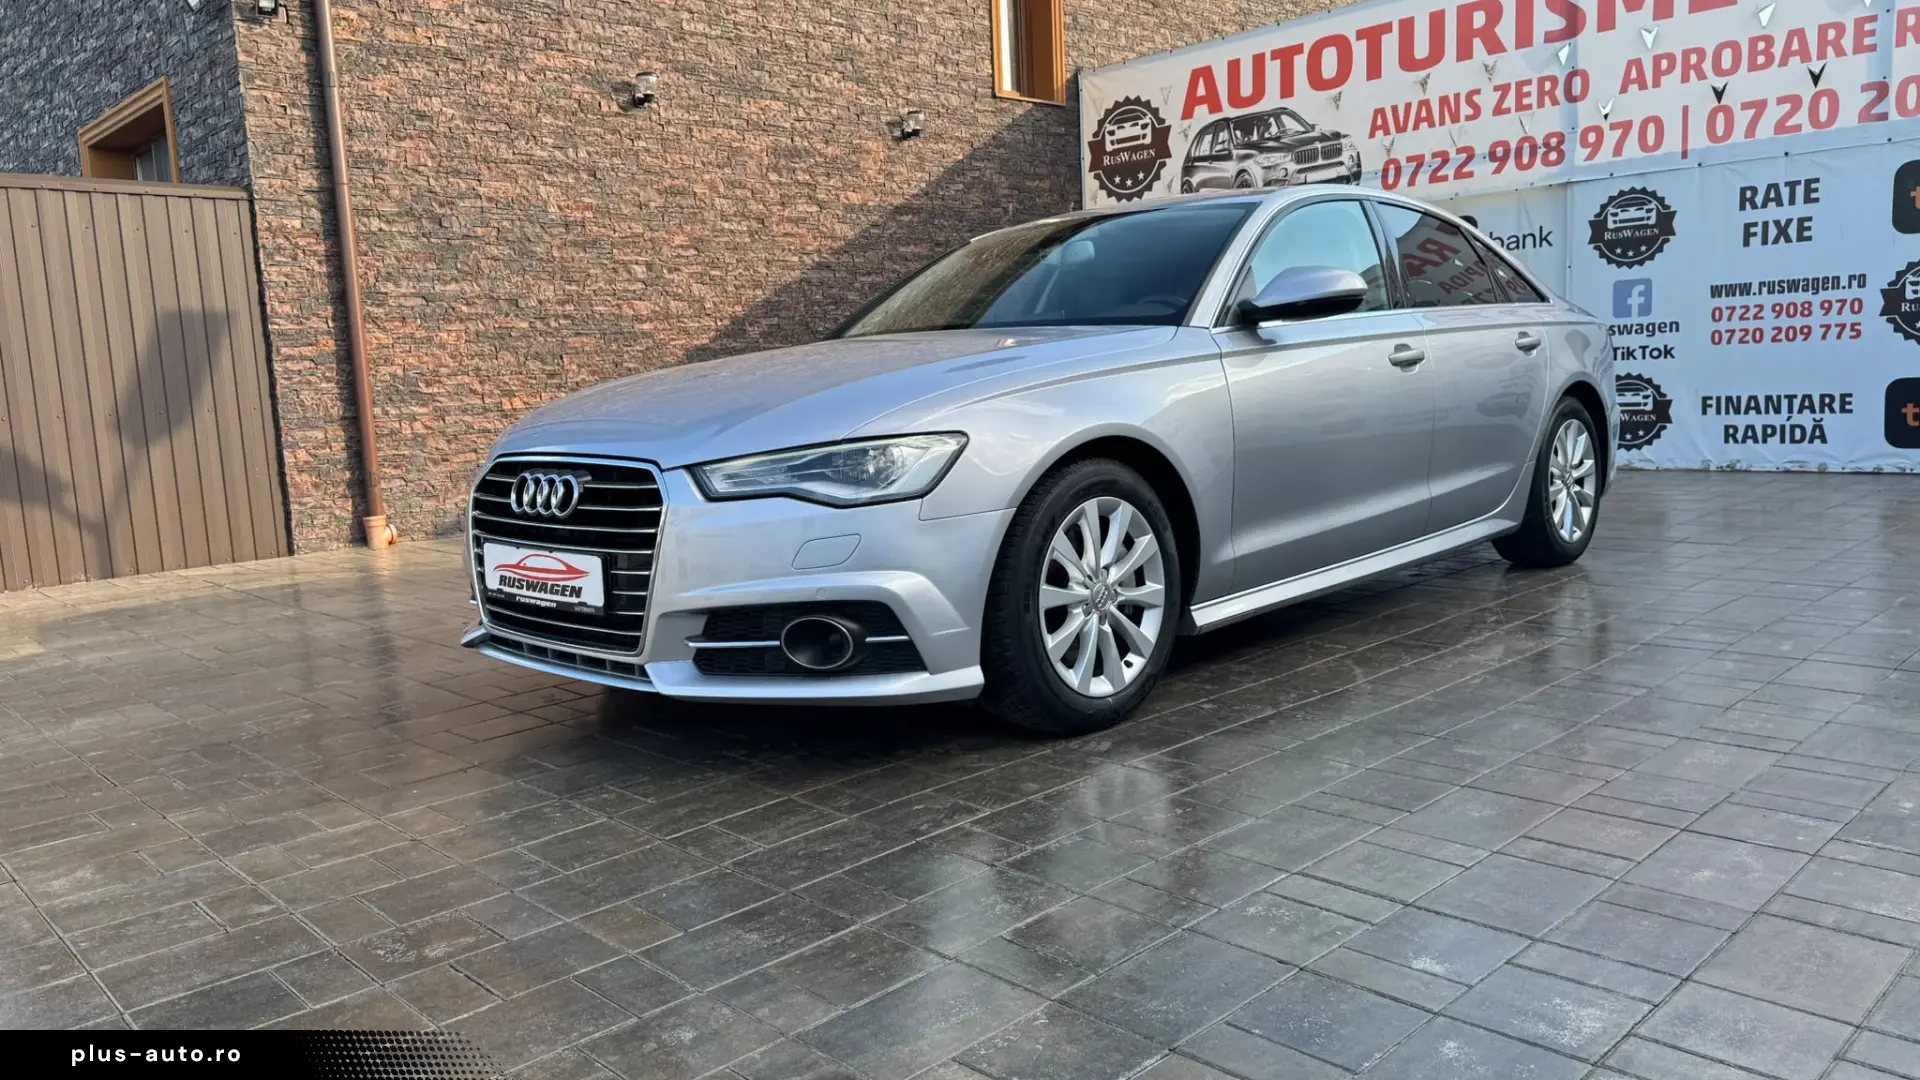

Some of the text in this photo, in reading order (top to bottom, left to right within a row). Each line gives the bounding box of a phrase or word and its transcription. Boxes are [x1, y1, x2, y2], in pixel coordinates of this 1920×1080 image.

[1181, 0, 1738, 120] AUTOTURIS
[1368, 88, 1482, 139] AVANS
[1492, 68, 1591, 117] ZERO
[1618, 14, 1879, 95] APROBARE
[1380, 145, 1476, 190] 0722
[1488, 131, 1565, 175] 908
[1579, 115, 1665, 162] 970
[1706, 88, 1840, 144] 0720
[1857, 74, 1920, 124] 20
[1738, 177, 1821, 212] RATE
[1742, 216, 1814, 248] FIXE
[1710, 273, 1867, 299] www.ruswagen.ro
[1711, 297, 1864, 323] 0722 908 970
[1710, 322, 1863, 346] 0720 209 775
[1613, 344, 1676, 361] TikTok
[1701, 392, 1854, 422] FINANȚARE
[1723, 417, 1829, 445] RAPIDĂ
[498, 574, 584, 599] RUSWAGEN
[516, 595, 557, 608] ruswagen
